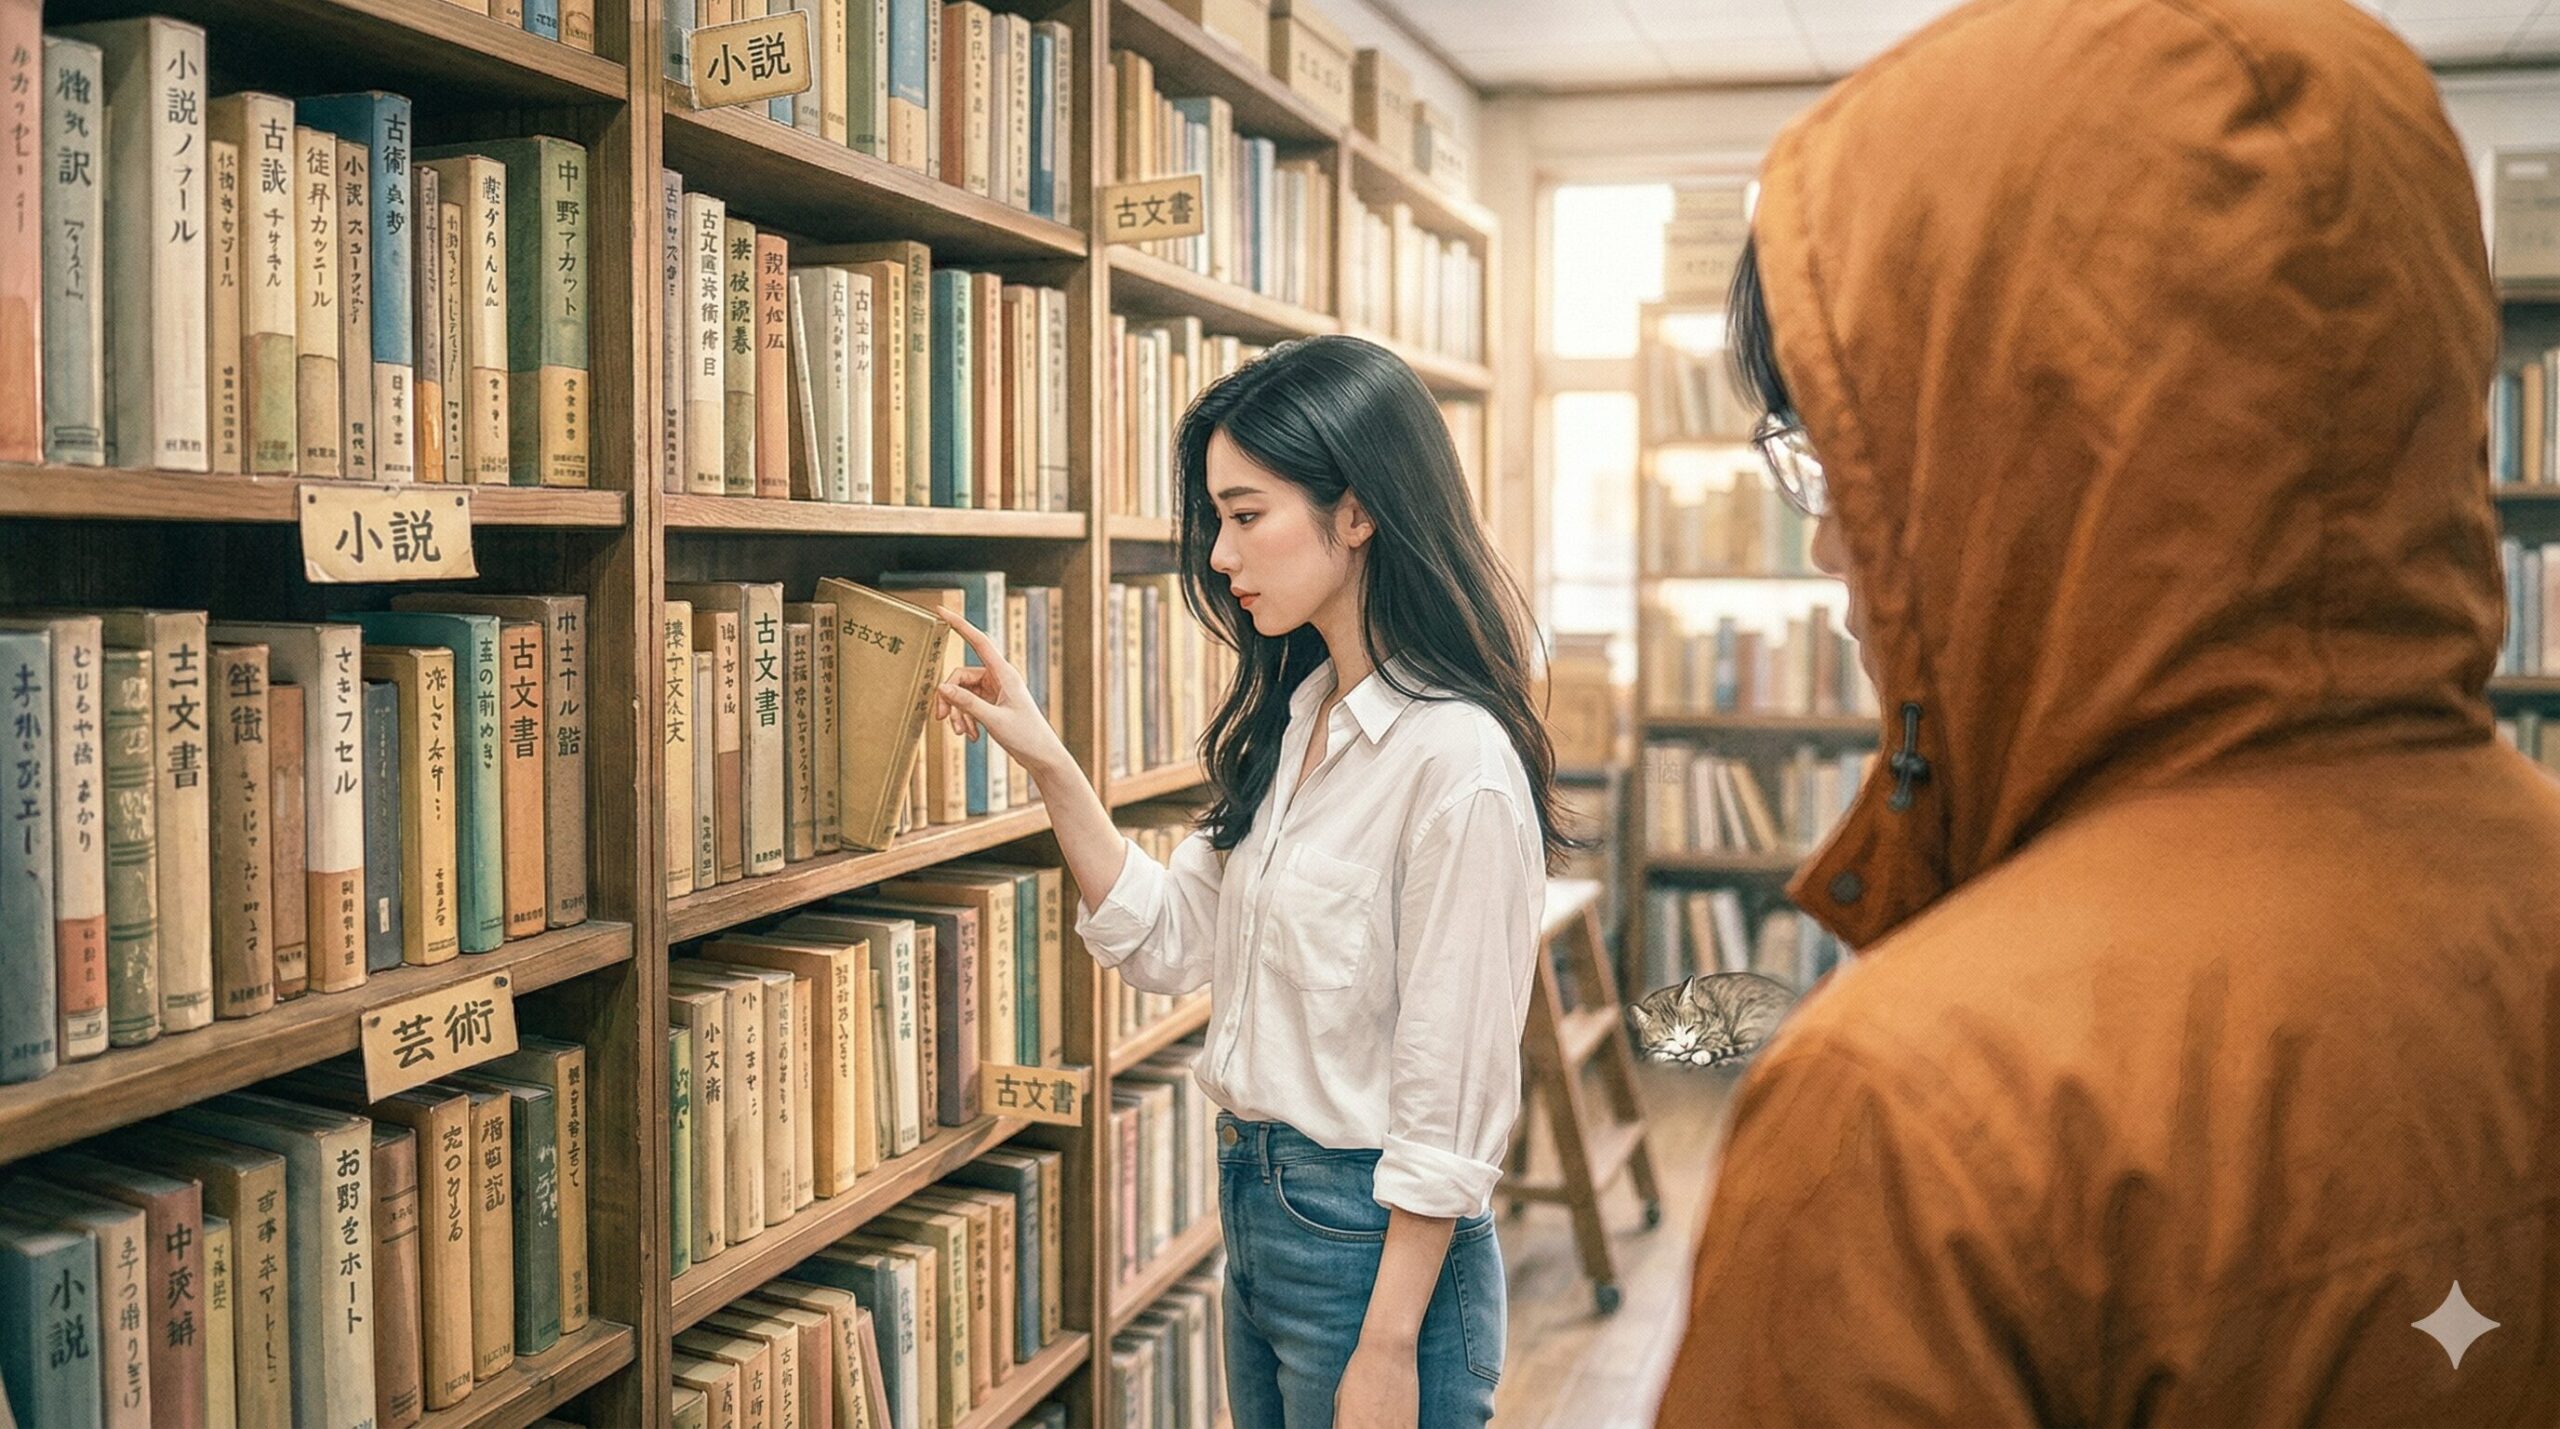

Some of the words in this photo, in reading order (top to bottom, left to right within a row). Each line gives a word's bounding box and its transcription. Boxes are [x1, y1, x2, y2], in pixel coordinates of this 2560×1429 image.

[706, 32, 792, 86] 小説
[1114, 190, 1194, 230] 古文書
[335, 510, 442, 563] 小説
[510, 636, 539, 759] 古文書
[754, 612, 780, 728] 古文書
[392, 999, 495, 1069] 芸術
[995, 1073, 1078, 1116] 古文書
[49, 1267, 90, 1370] 小説
